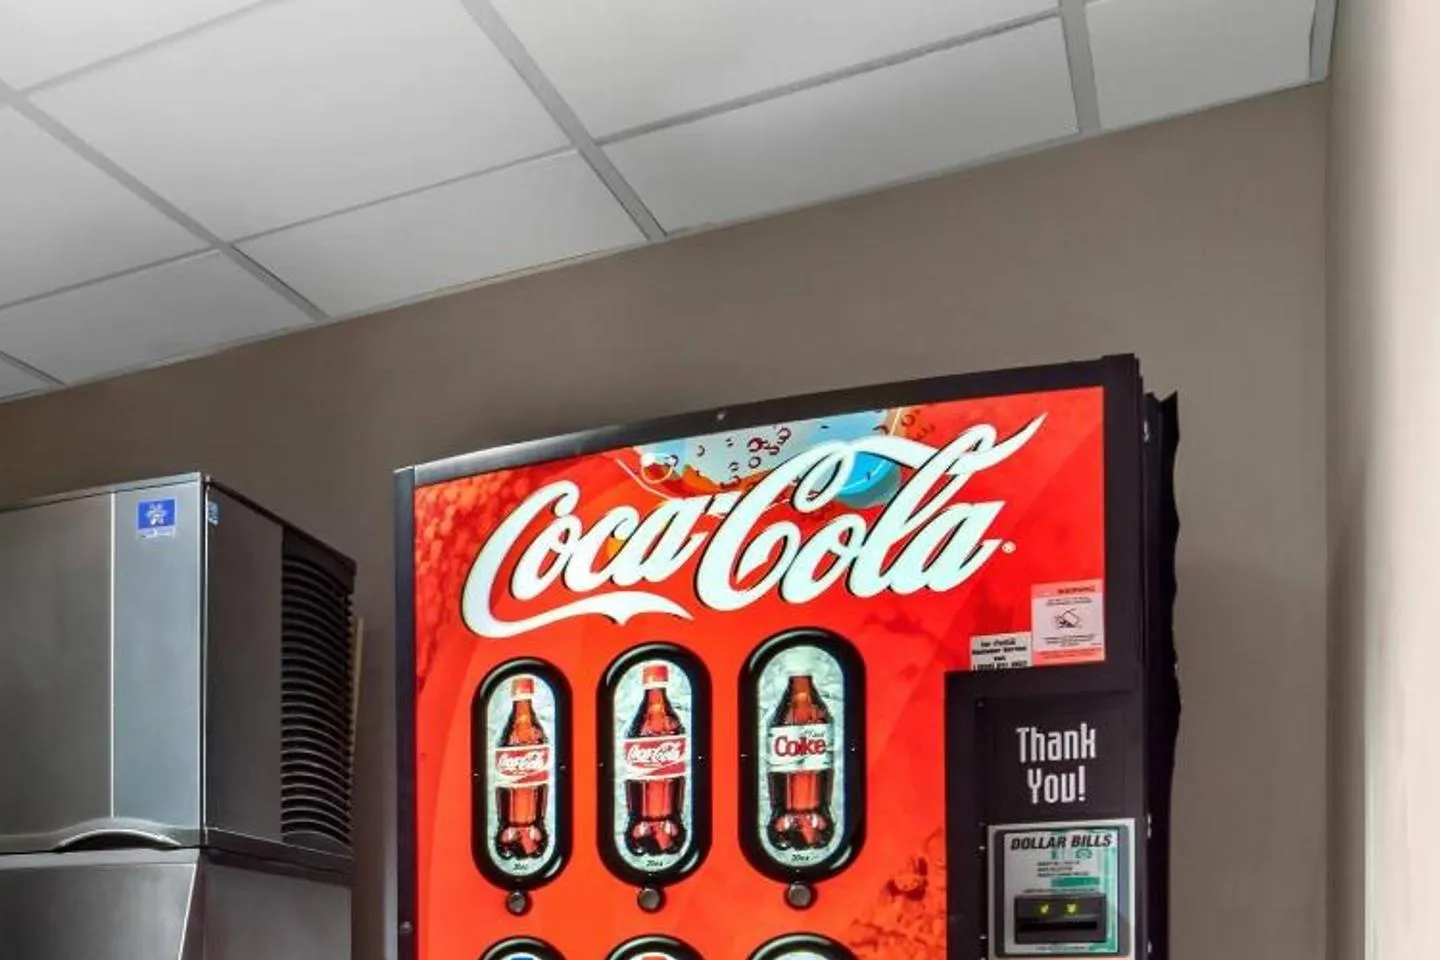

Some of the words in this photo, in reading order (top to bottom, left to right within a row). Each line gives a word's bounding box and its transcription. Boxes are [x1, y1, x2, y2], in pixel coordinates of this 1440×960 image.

[461, 411, 1047, 638] Coca-Cola
[774, 735, 827, 757] Coke
[1016, 722, 1097, 763] Thank
[1027, 765, 1086, 804] You!
[1011, 835, 1066, 850] DOLLAR
[1071, 833, 1113, 848] BILLS
